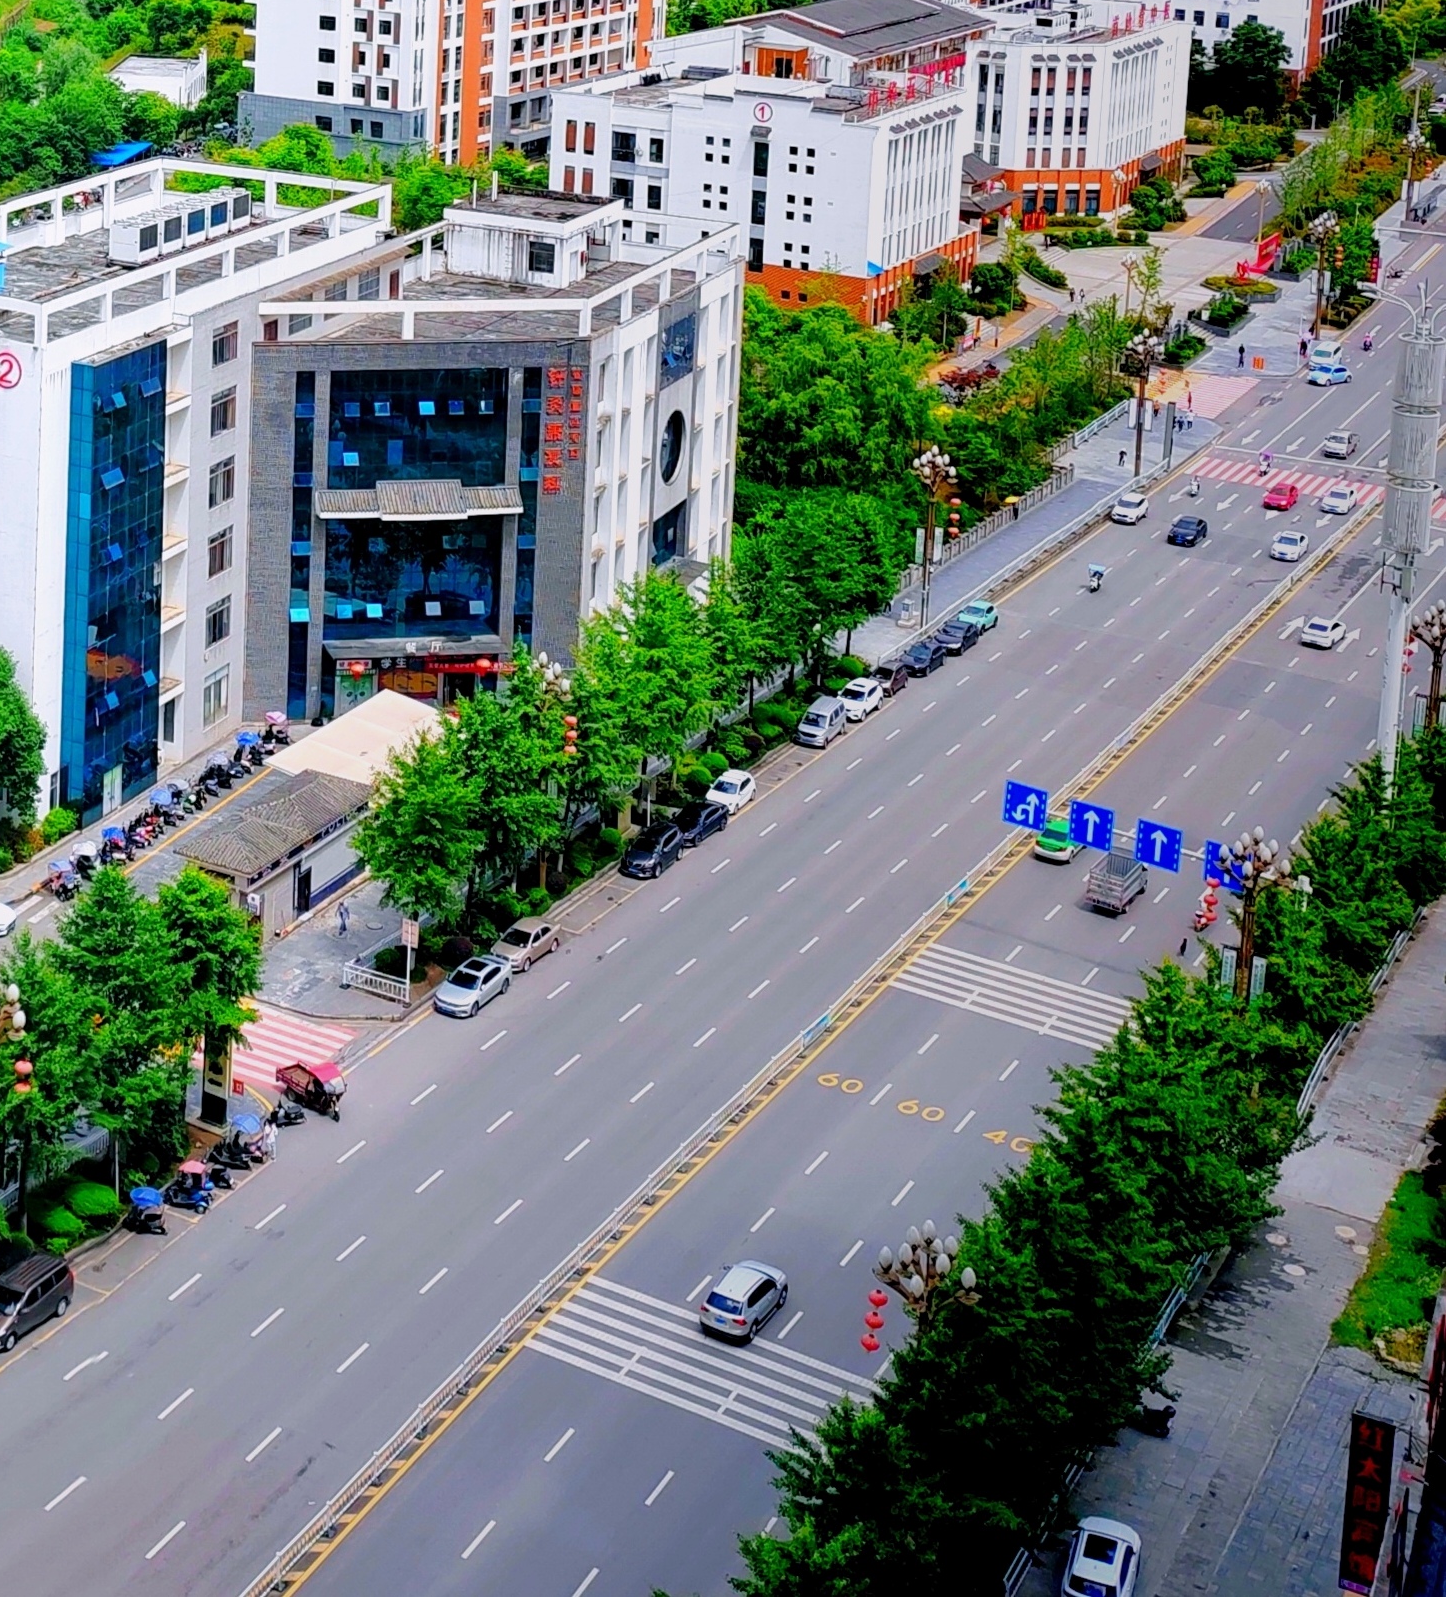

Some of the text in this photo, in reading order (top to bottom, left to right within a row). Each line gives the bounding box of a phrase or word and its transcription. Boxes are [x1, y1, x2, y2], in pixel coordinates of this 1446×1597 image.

[405, 641, 444, 653] 餐厅
[380, 658, 408, 669] 学生
[817, 1073, 864, 1093] 60
[897, 1099, 945, 1122] 60
